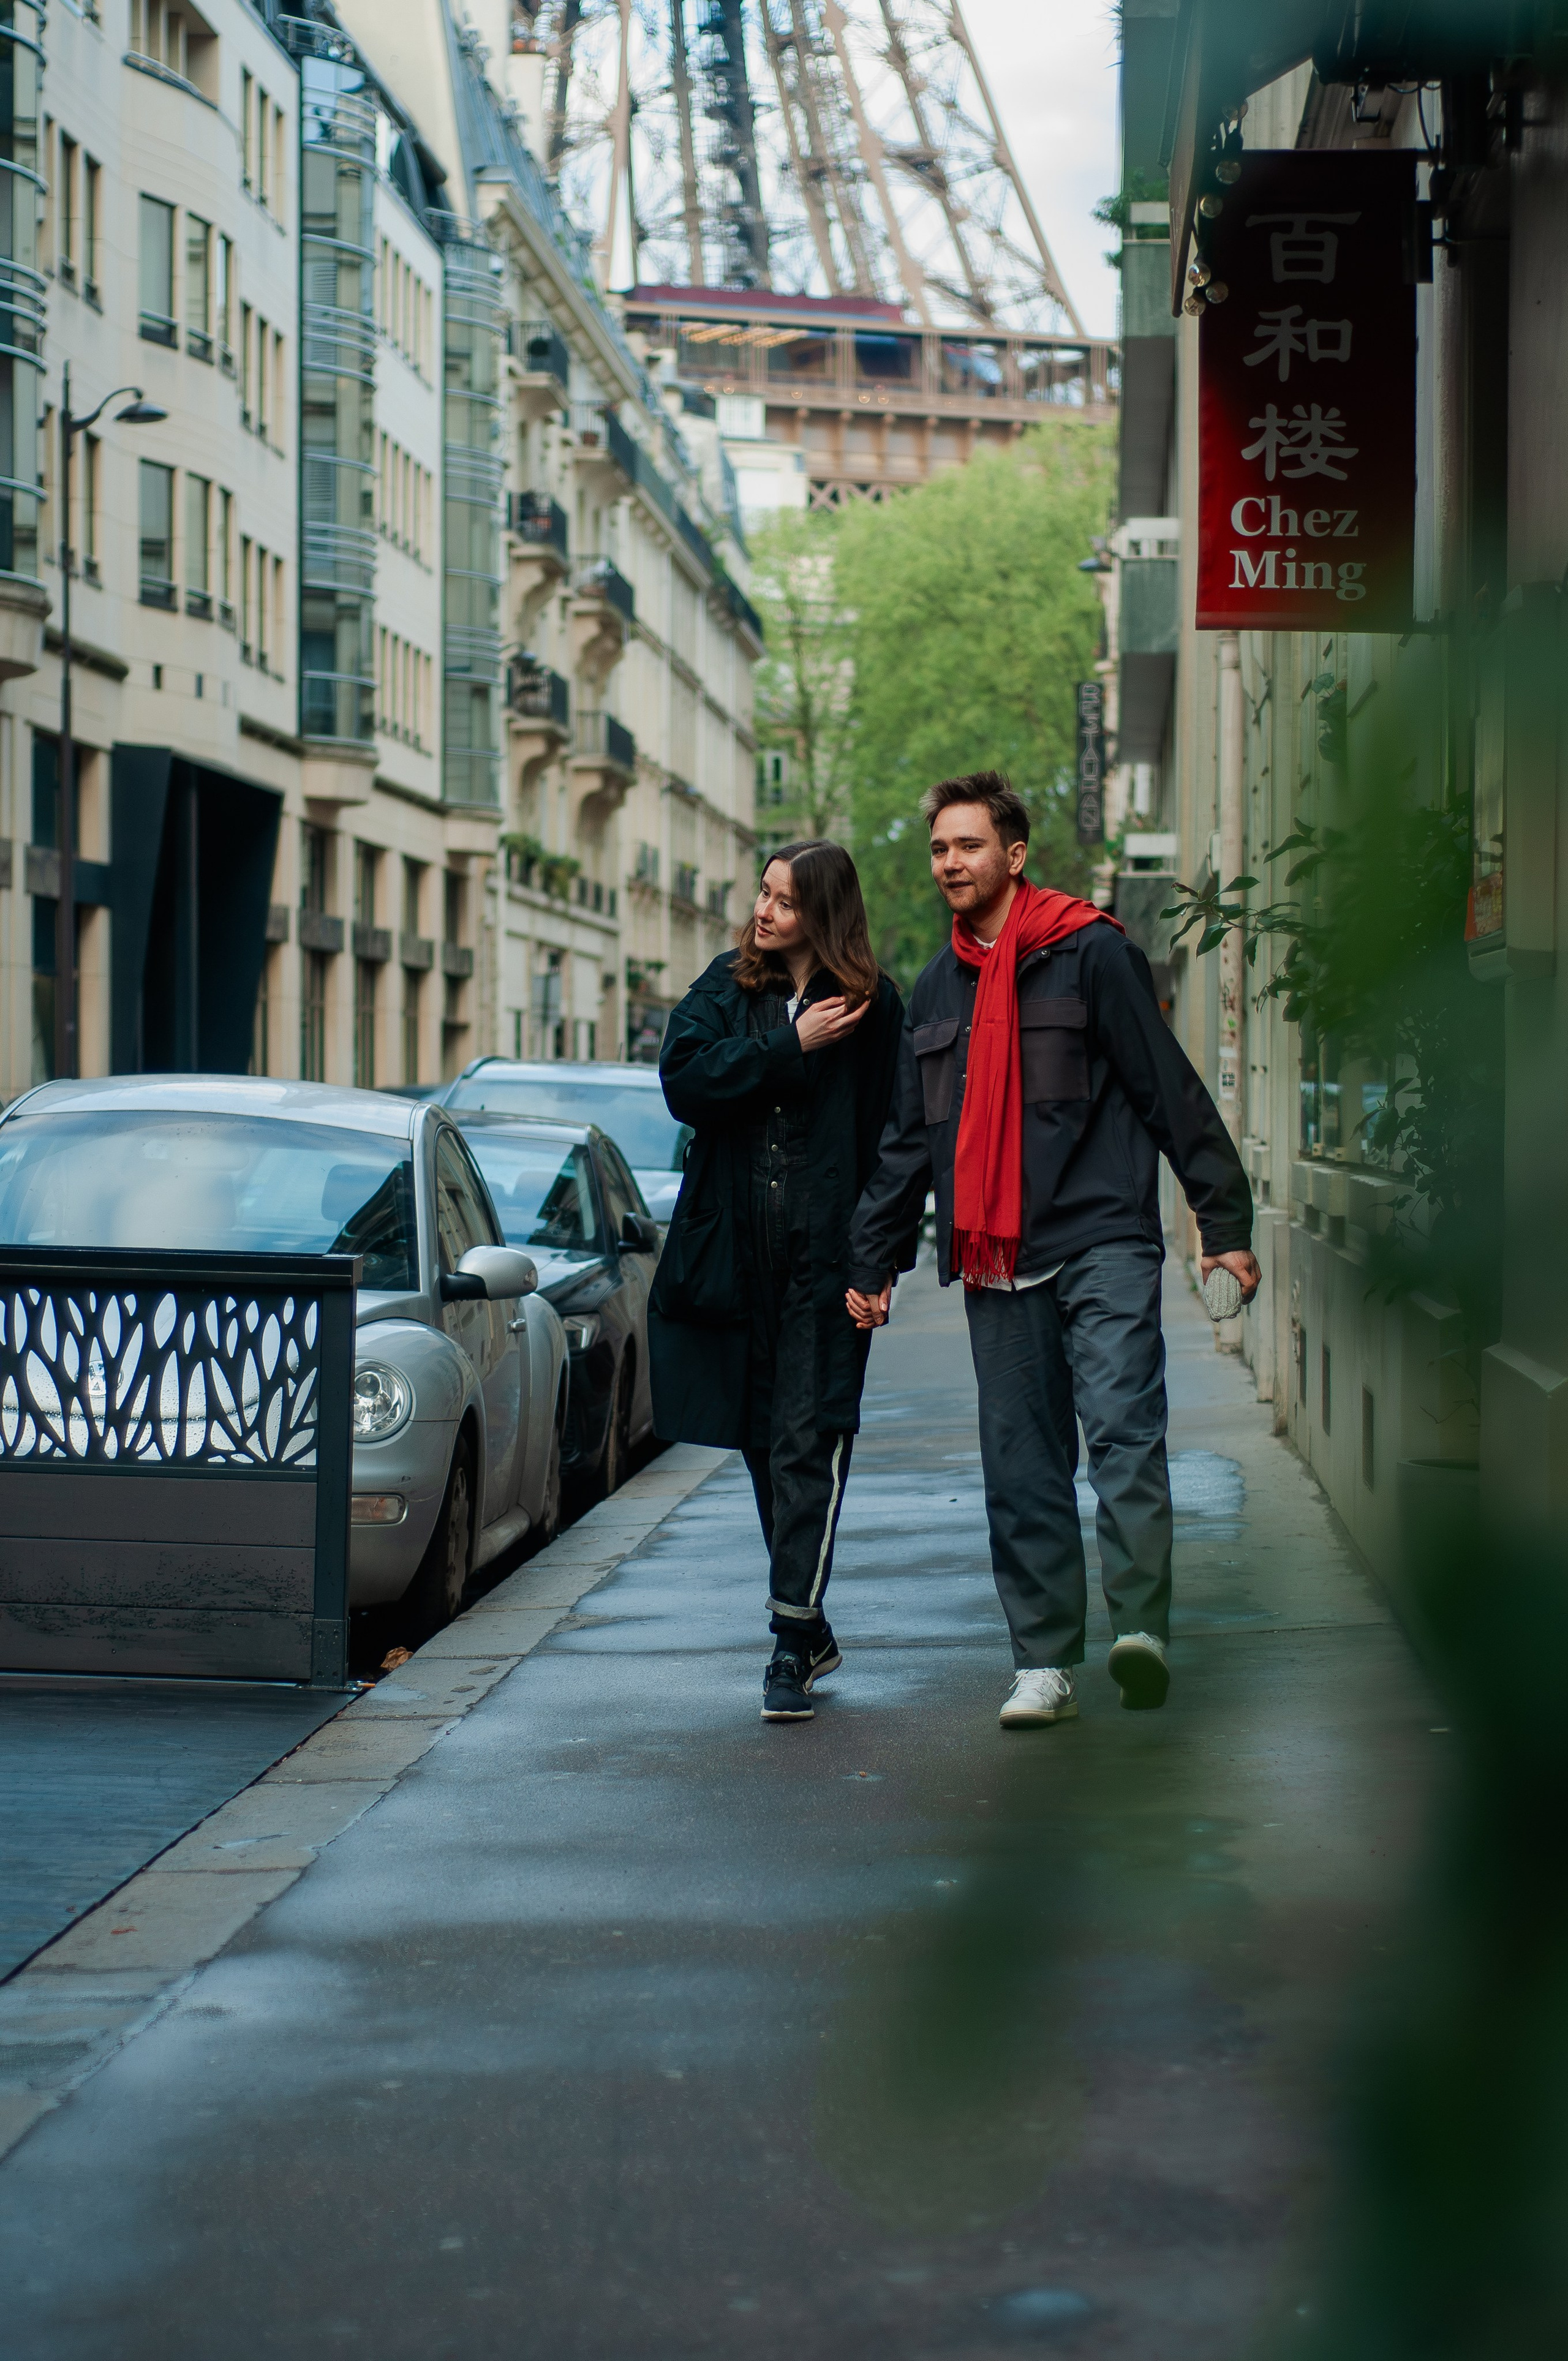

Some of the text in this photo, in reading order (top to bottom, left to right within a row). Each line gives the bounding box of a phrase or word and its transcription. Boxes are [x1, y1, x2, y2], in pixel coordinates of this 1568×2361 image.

[1241, 211, 1362, 481] 百和楼
[1231, 495, 1359, 537] Chez
[1228, 549, 1366, 601] Ming
